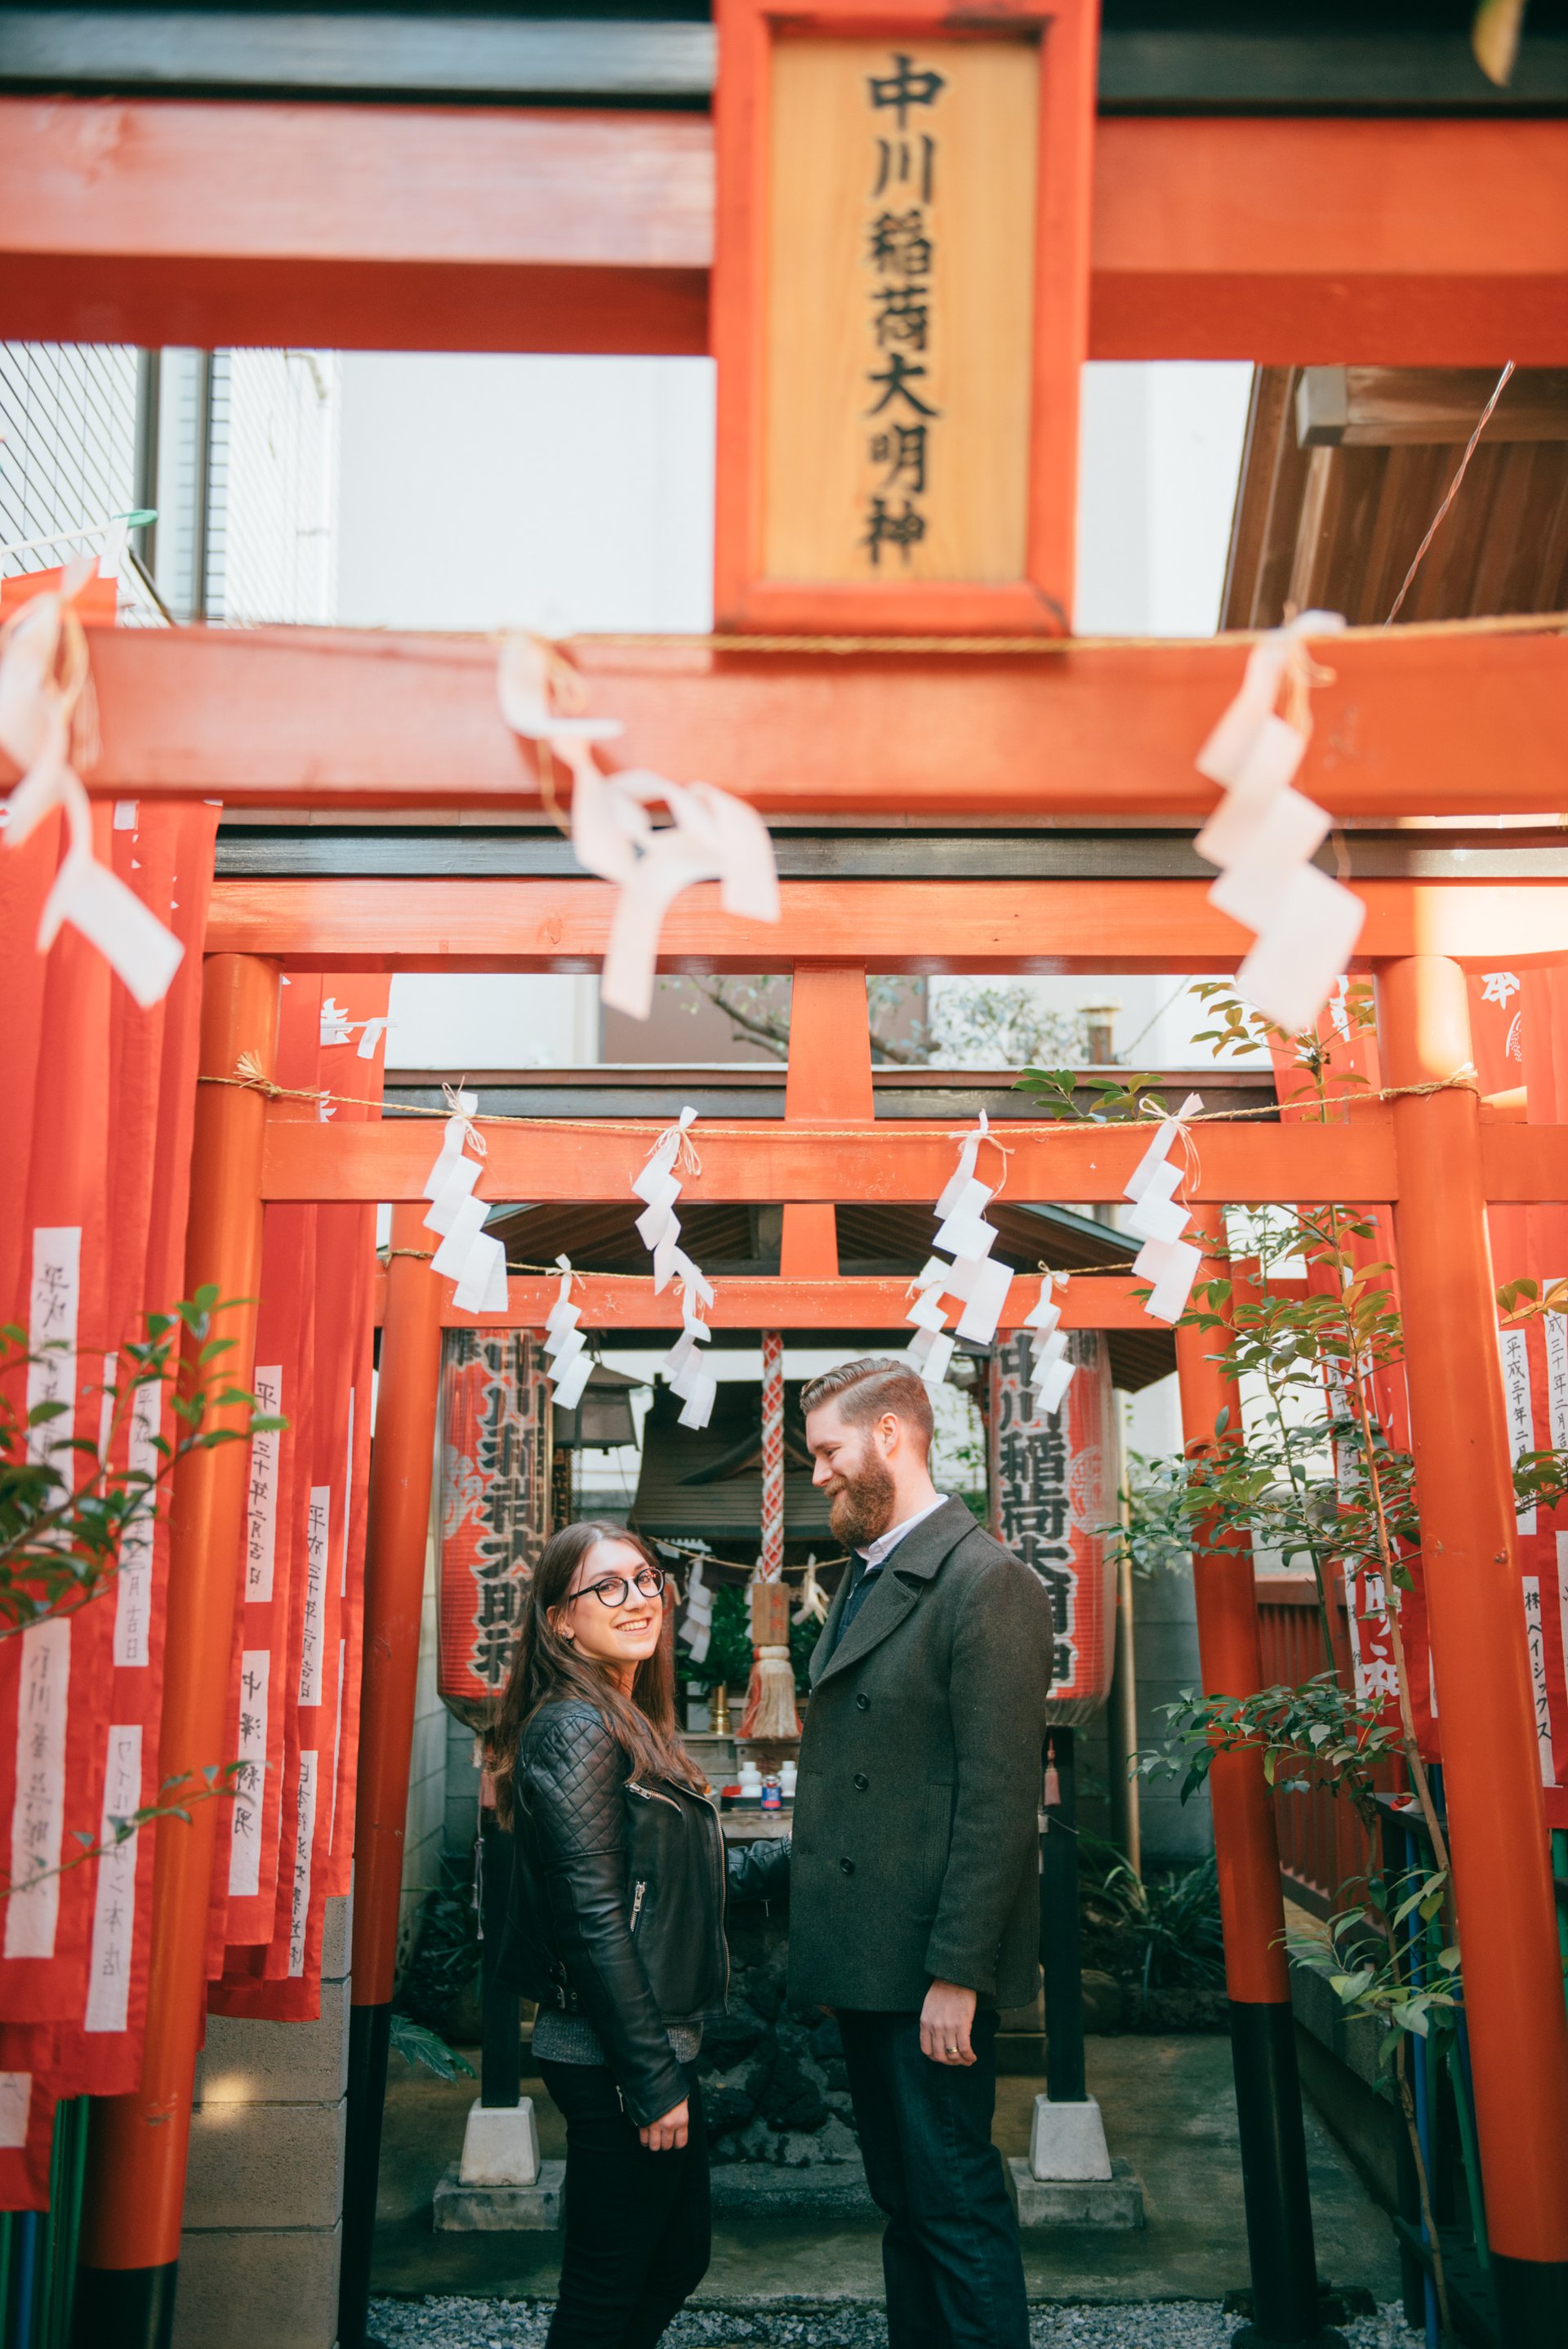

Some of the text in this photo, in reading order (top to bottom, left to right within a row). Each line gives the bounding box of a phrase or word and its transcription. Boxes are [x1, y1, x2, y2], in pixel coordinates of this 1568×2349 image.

[862, 53, 947, 567] 中川稲荷大明神
[1547, 1309, 1568, 1449] 成三十年二月吉
